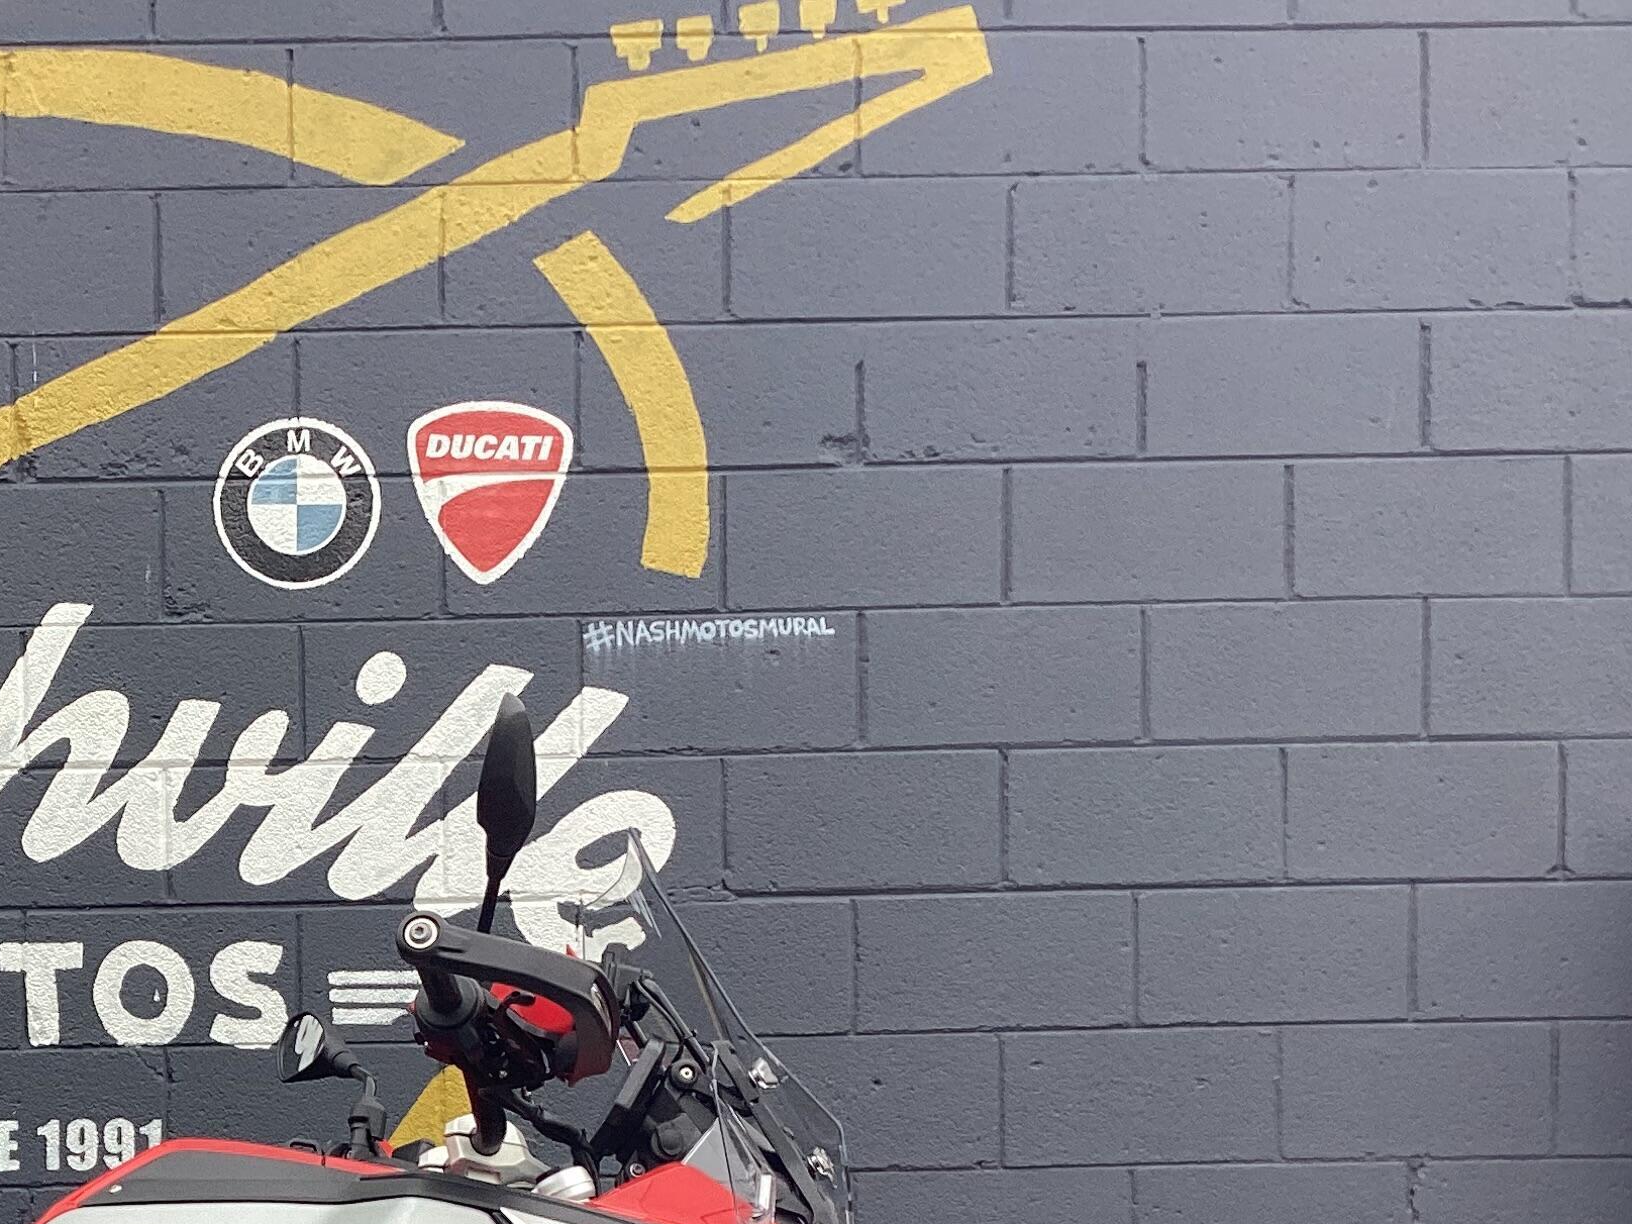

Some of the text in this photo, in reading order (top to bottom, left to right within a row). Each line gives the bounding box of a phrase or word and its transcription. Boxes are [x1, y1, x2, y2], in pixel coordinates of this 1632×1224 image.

[235, 428, 363, 479] BMW
[425, 433, 554, 462] DUCATI
[582, 616, 836, 651] #NASHMOTOSMURAL
[37, 1118, 164, 1171] 1991
